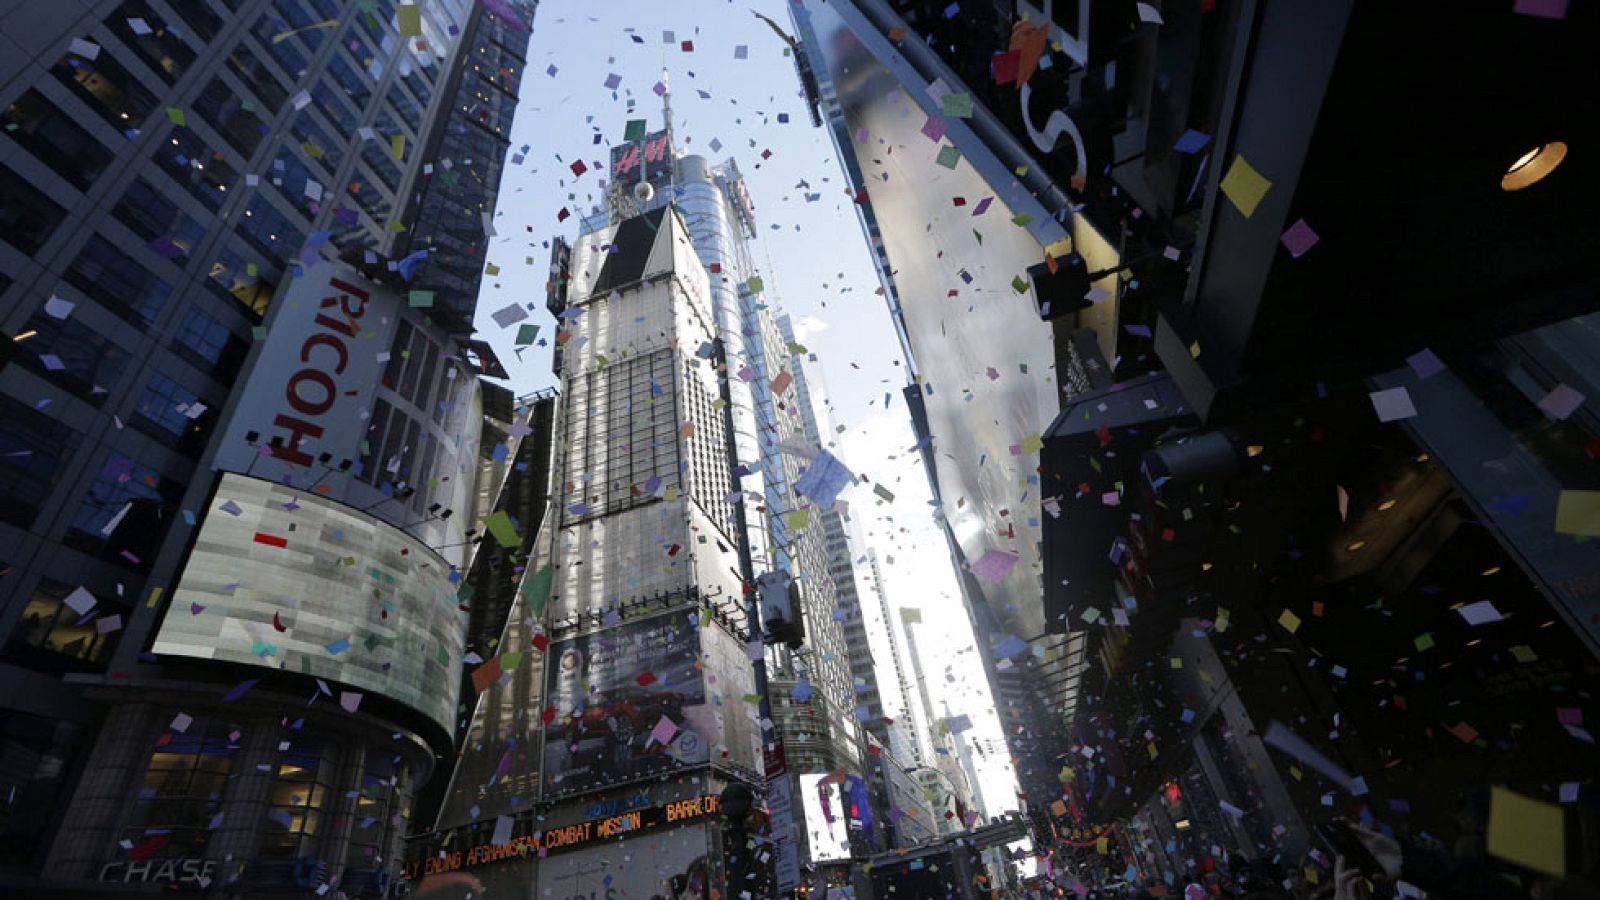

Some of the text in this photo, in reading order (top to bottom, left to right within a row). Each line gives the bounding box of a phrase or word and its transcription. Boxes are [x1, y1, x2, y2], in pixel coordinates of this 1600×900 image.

[266, 277, 370, 467] RICOH
[546, 822, 592, 849] COMBAT
[597, 811, 641, 838] MISSON
[98, 858, 216, 884] CHASE
